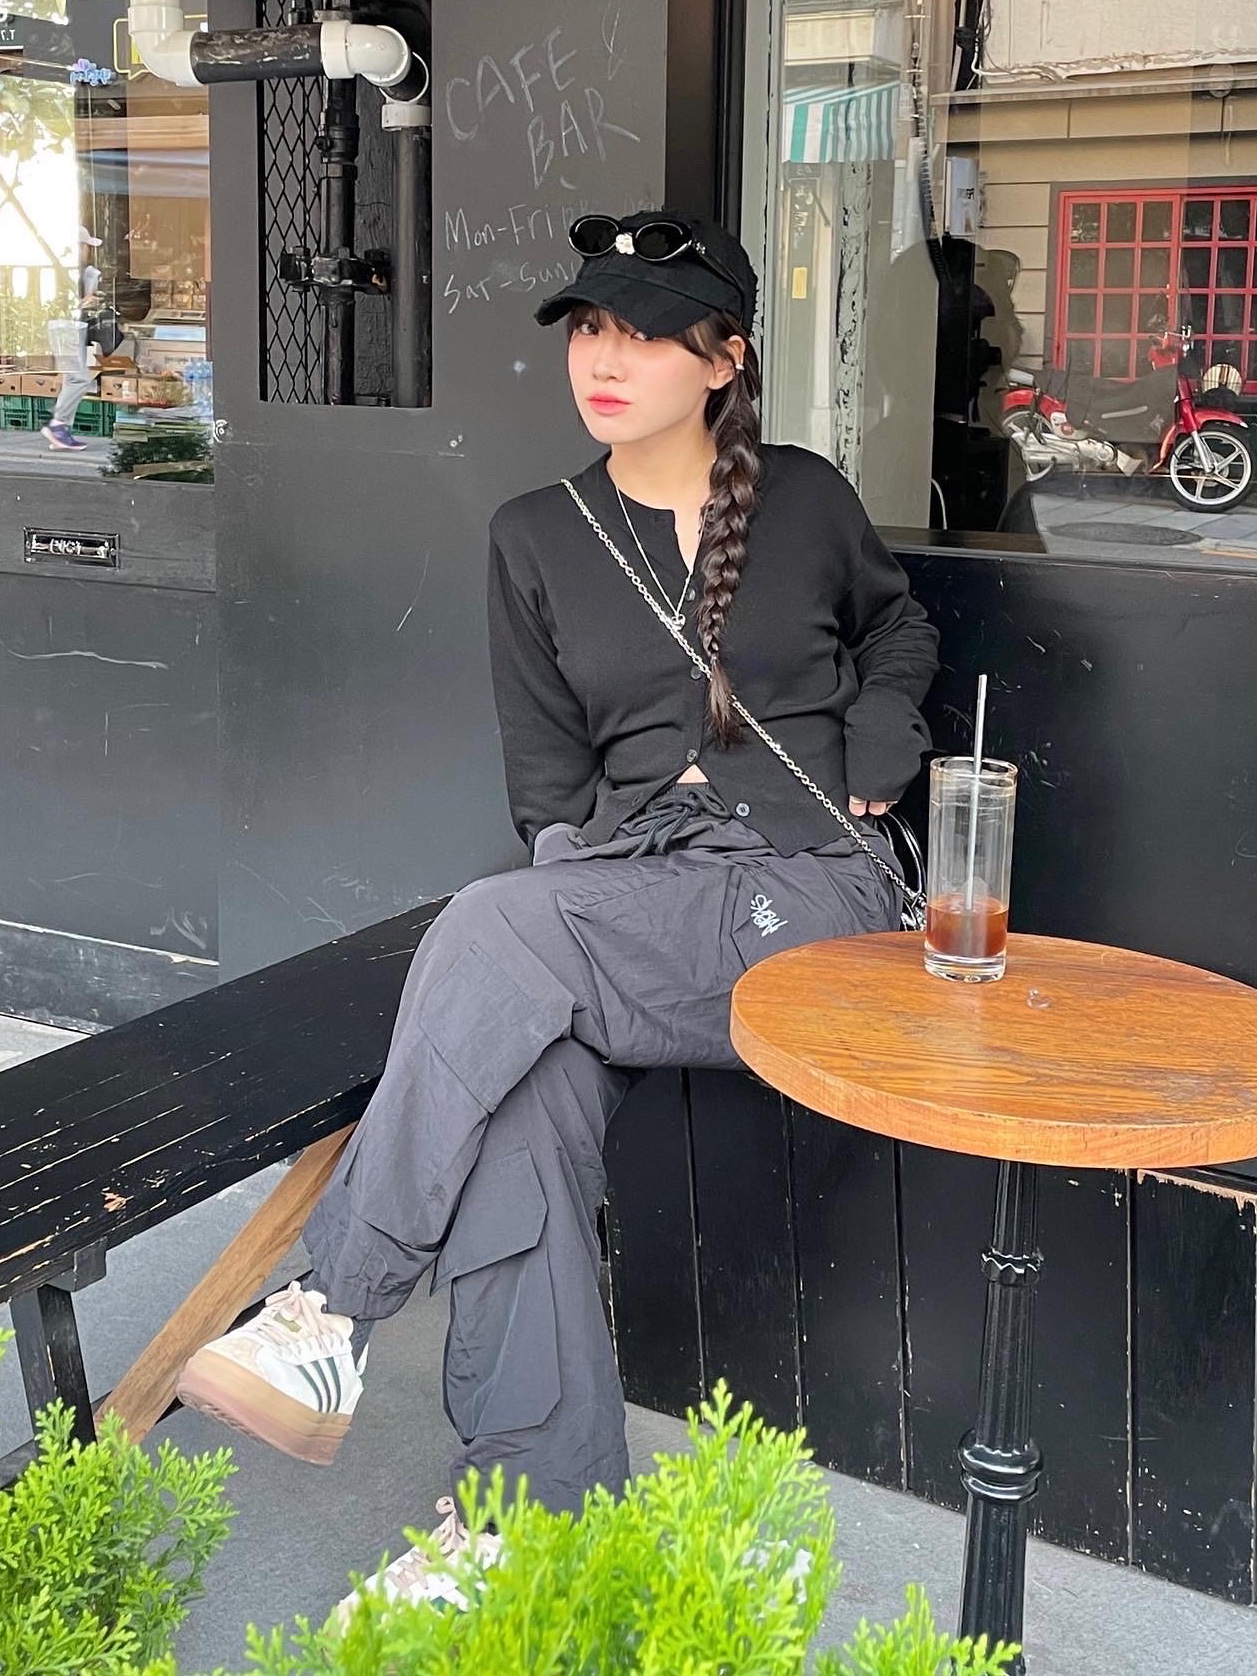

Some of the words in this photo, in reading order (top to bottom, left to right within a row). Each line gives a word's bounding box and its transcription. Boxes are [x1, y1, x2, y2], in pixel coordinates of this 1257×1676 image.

[446, 26, 577, 141] CAFE
[526, 88, 640, 189] BAR
[444, 203, 554, 252] Mon-Fri
